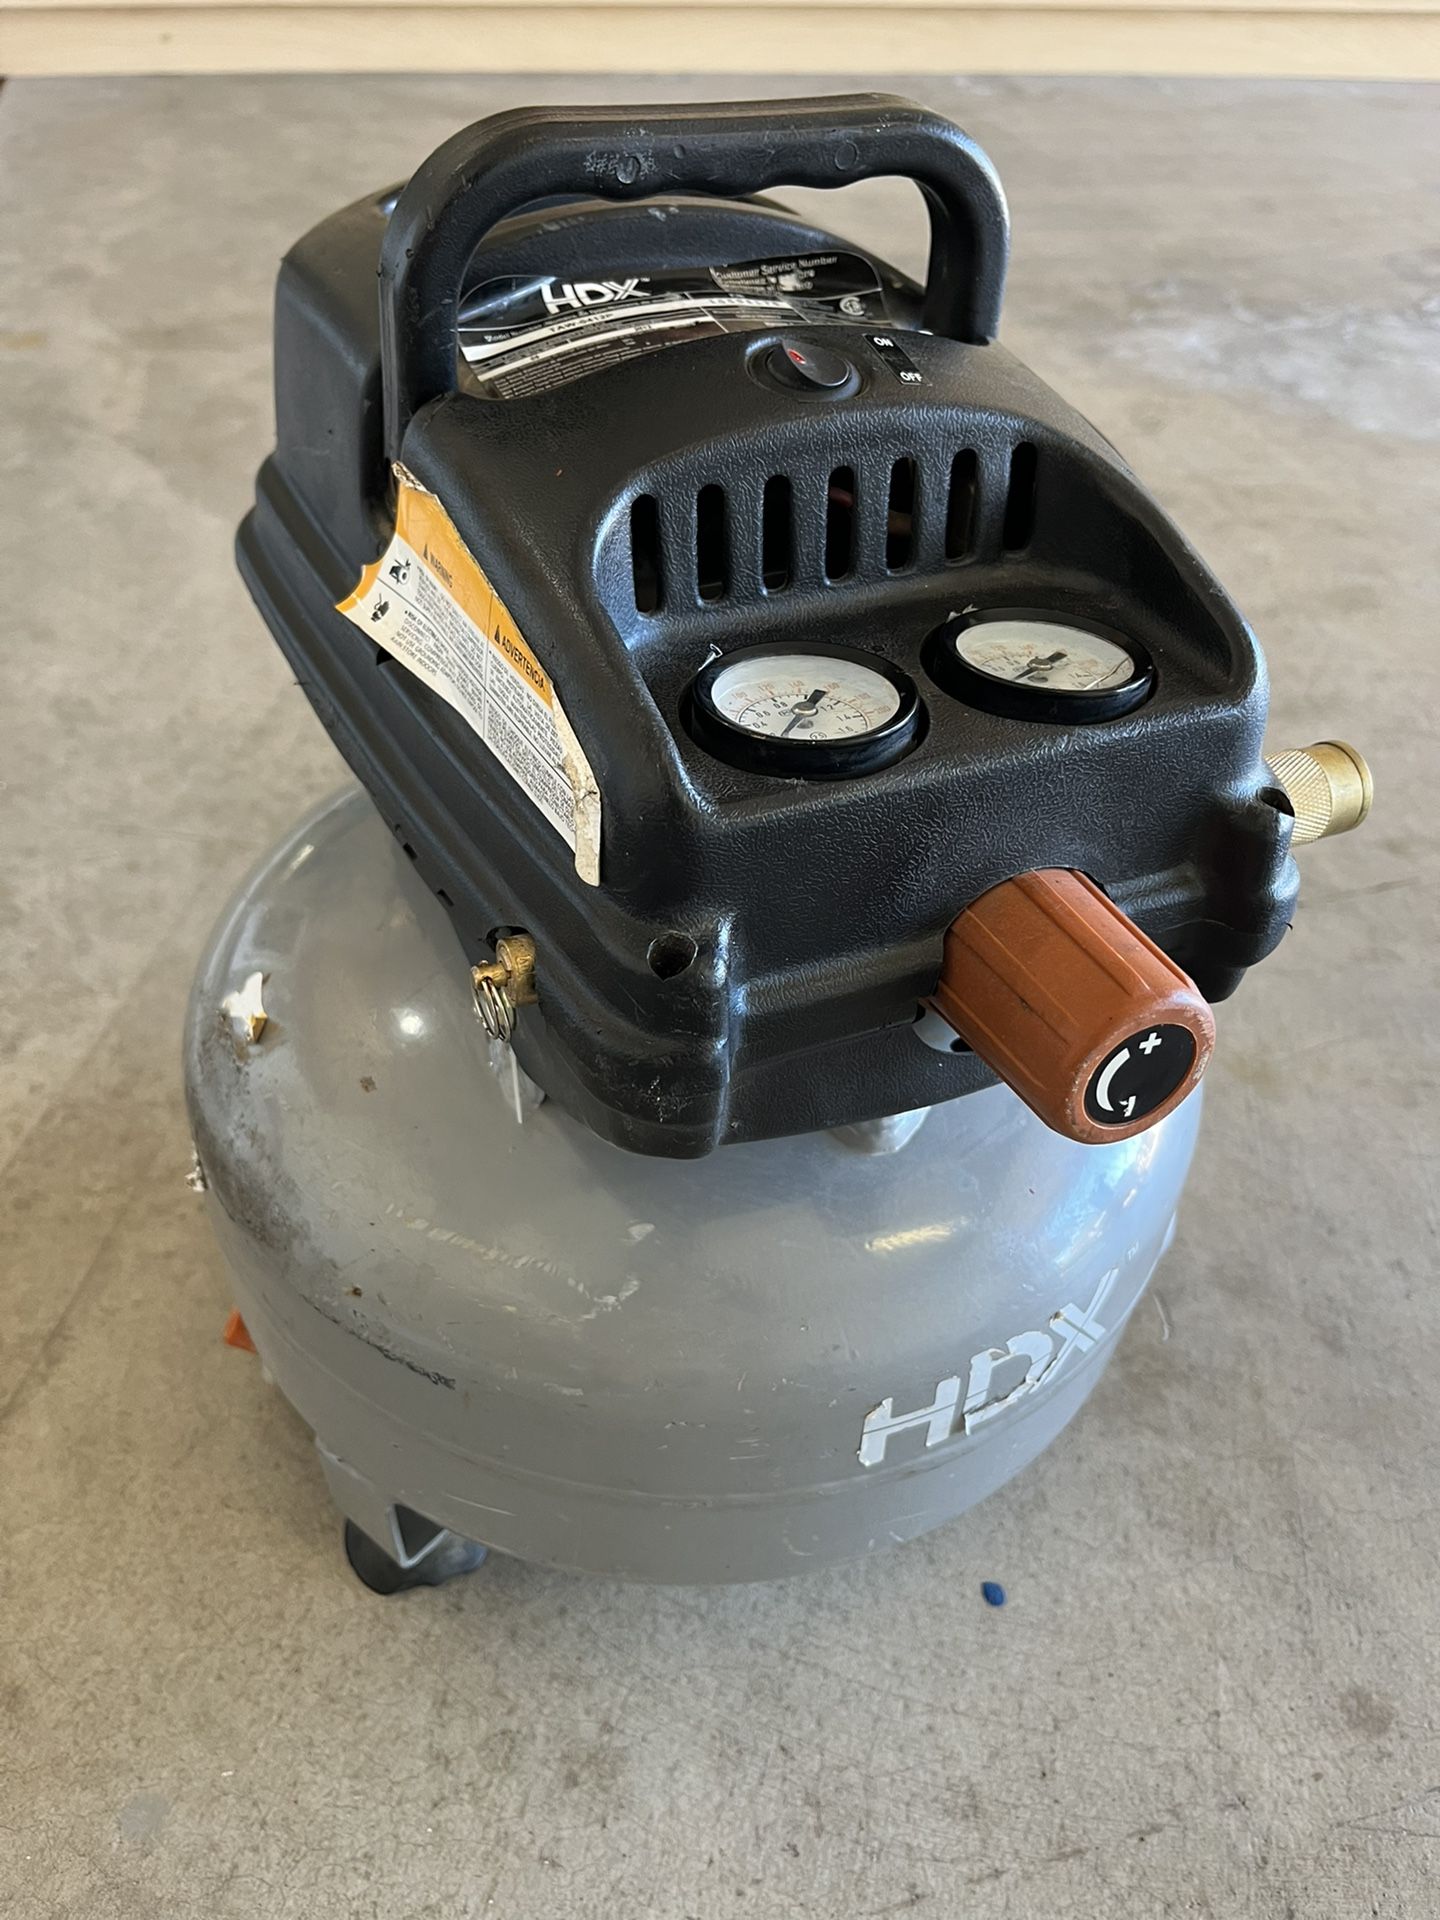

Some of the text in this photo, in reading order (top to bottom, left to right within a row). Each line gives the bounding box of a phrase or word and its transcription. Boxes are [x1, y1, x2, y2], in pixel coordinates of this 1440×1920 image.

[540, 278, 652, 315] HDX
[873, 337, 894, 347] ON
[899, 371, 923, 382] OFF
[502, 635, 545, 692] ADVERTENCIA
[857, 1268, 1119, 1467] HDX
